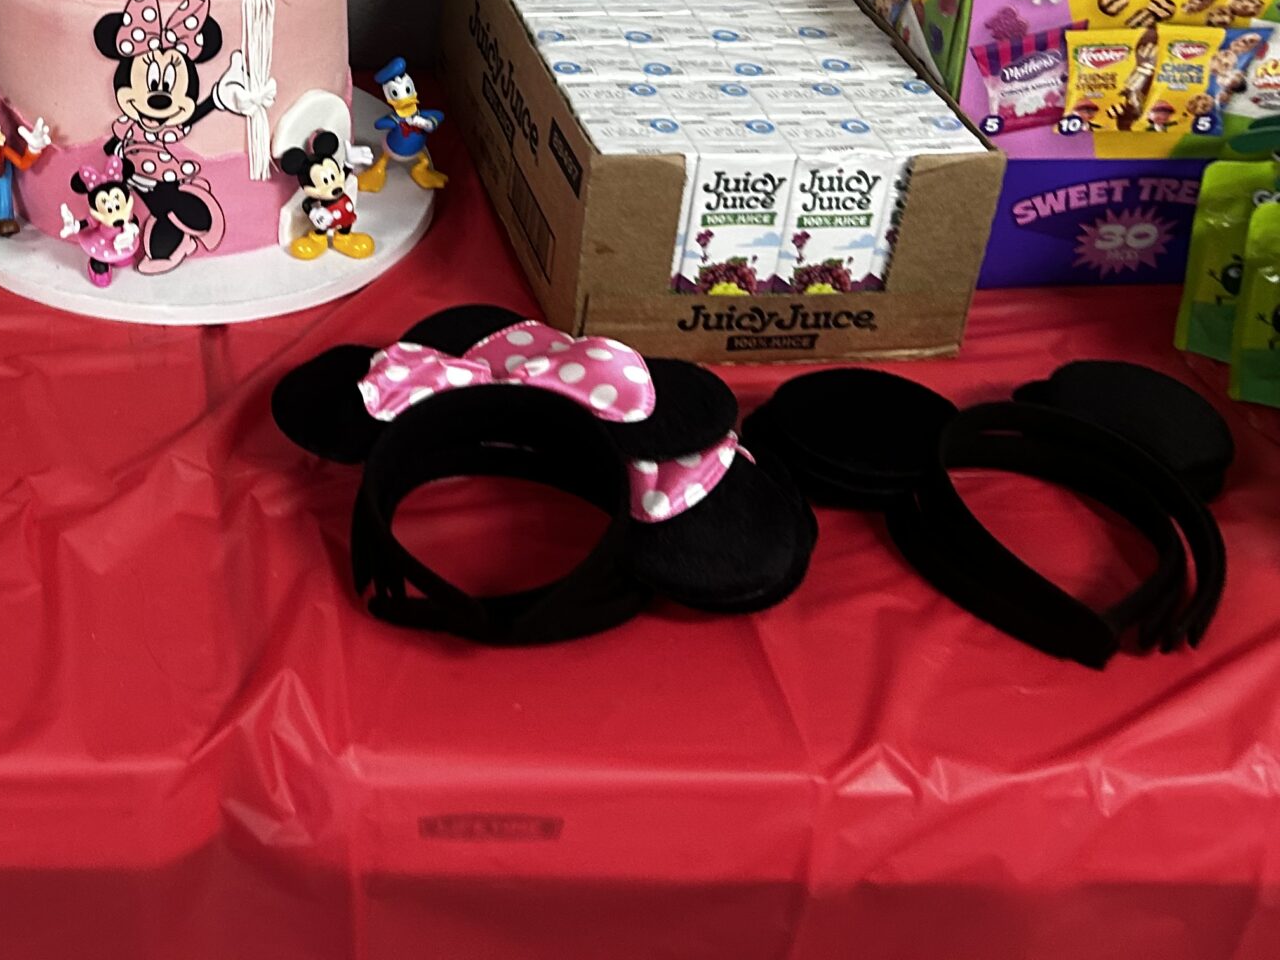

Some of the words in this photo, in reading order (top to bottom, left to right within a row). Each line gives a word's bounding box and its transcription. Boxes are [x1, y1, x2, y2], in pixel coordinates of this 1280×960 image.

[984, 118, 999, 132] 5
[1060, 118, 1081, 132] 10
[1196, 116, 1212, 131] 5
[703, 170, 787, 198] Juicy
[800, 169, 882, 198] Juicy
[705, 191, 775, 212] Juice
[802, 191, 871, 213] Juice
[1012, 178, 1130, 226] SWEET
[735, 214, 770, 224] JUICE
[832, 215, 868, 226] JUICE
[1094, 223, 1160, 250] 30
